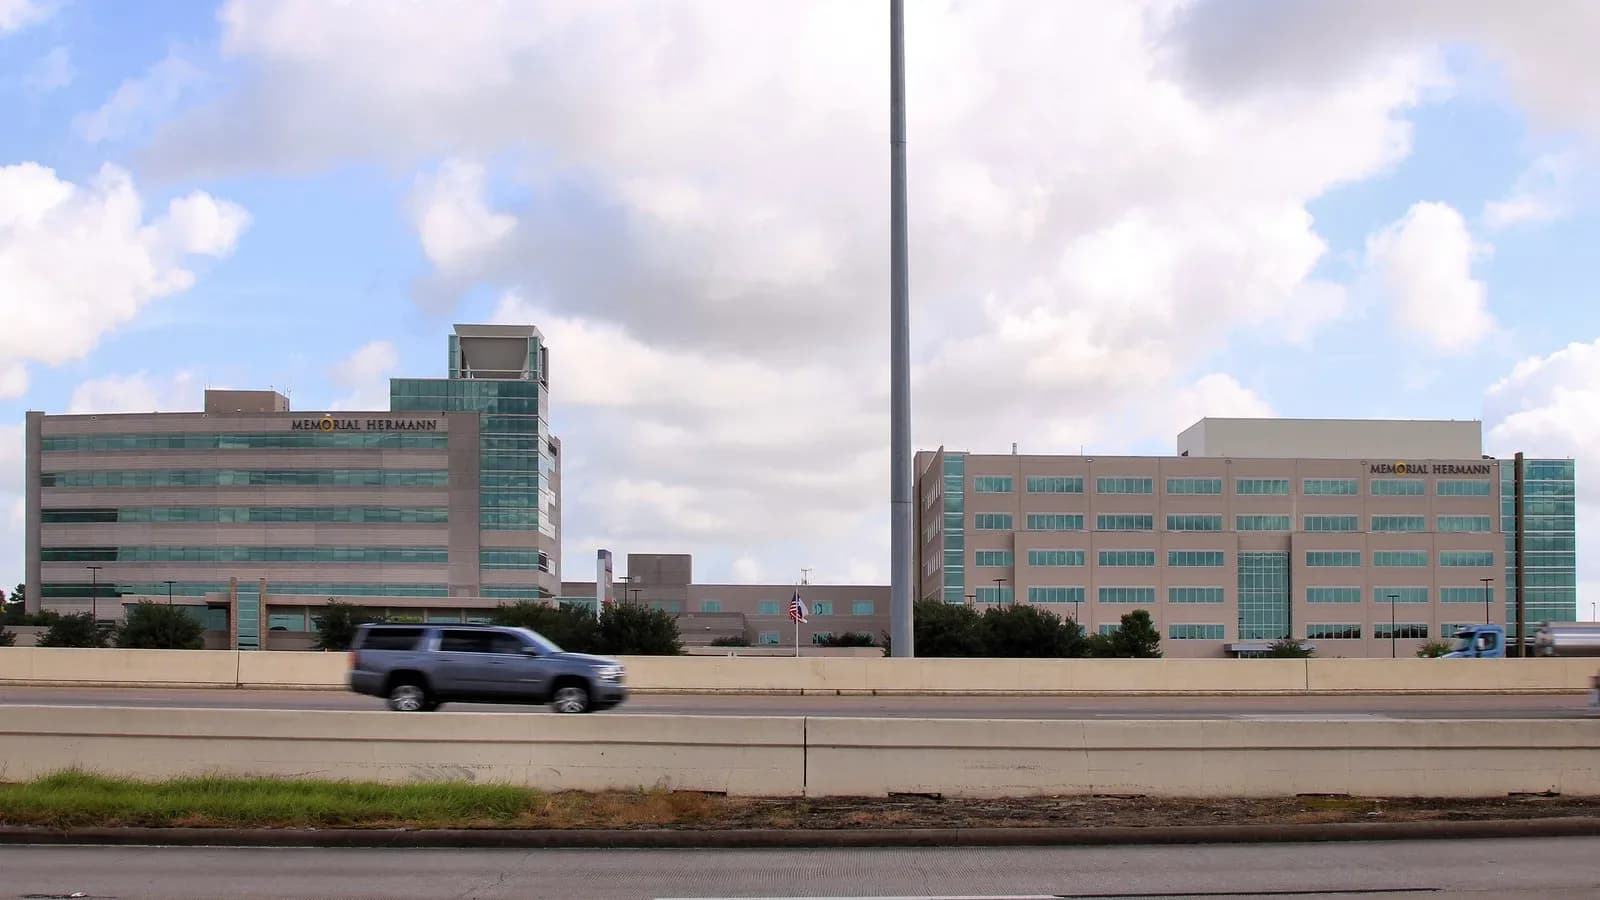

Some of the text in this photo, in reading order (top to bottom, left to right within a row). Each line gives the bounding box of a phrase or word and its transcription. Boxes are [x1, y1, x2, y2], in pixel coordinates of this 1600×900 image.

[292, 418, 437, 431] MEMORIAL HERMANN
[1370, 463, 1491, 474] MEMORIAL HERMANN
